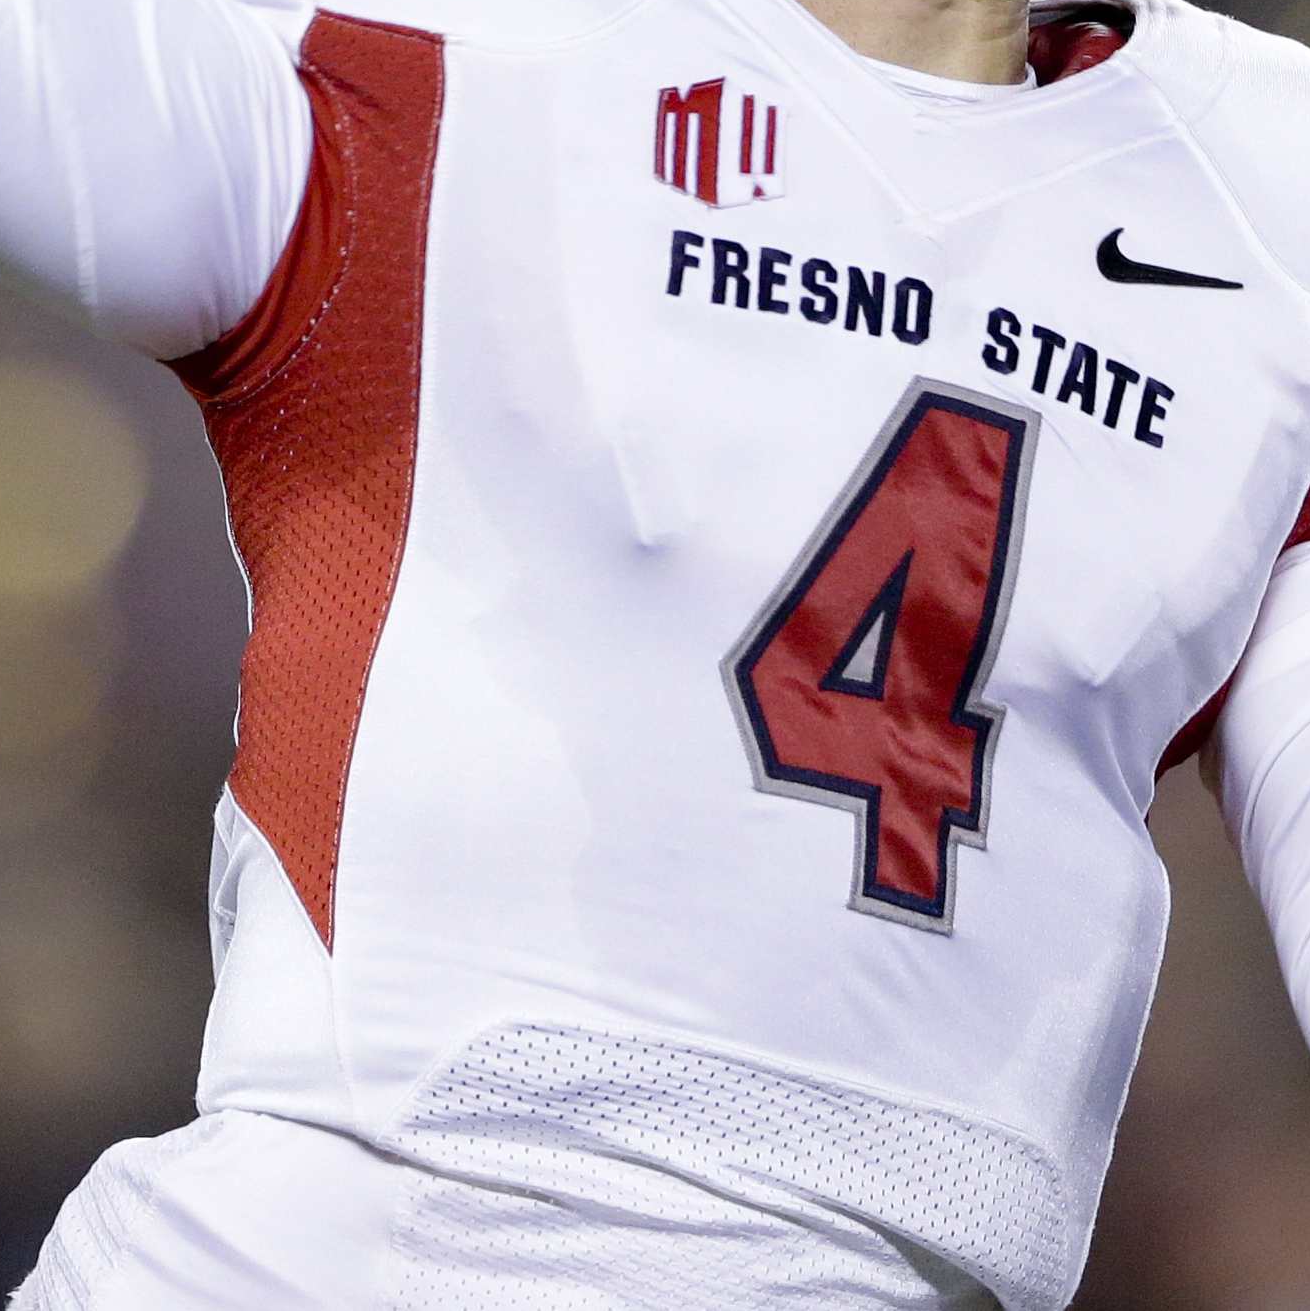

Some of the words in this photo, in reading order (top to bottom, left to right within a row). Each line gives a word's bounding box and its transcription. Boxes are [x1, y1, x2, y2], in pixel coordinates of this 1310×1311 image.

[665, 230, 934, 346] FRESNO
[981, 307, 1175, 449] STATE
[719, 374, 1042, 937] 4
